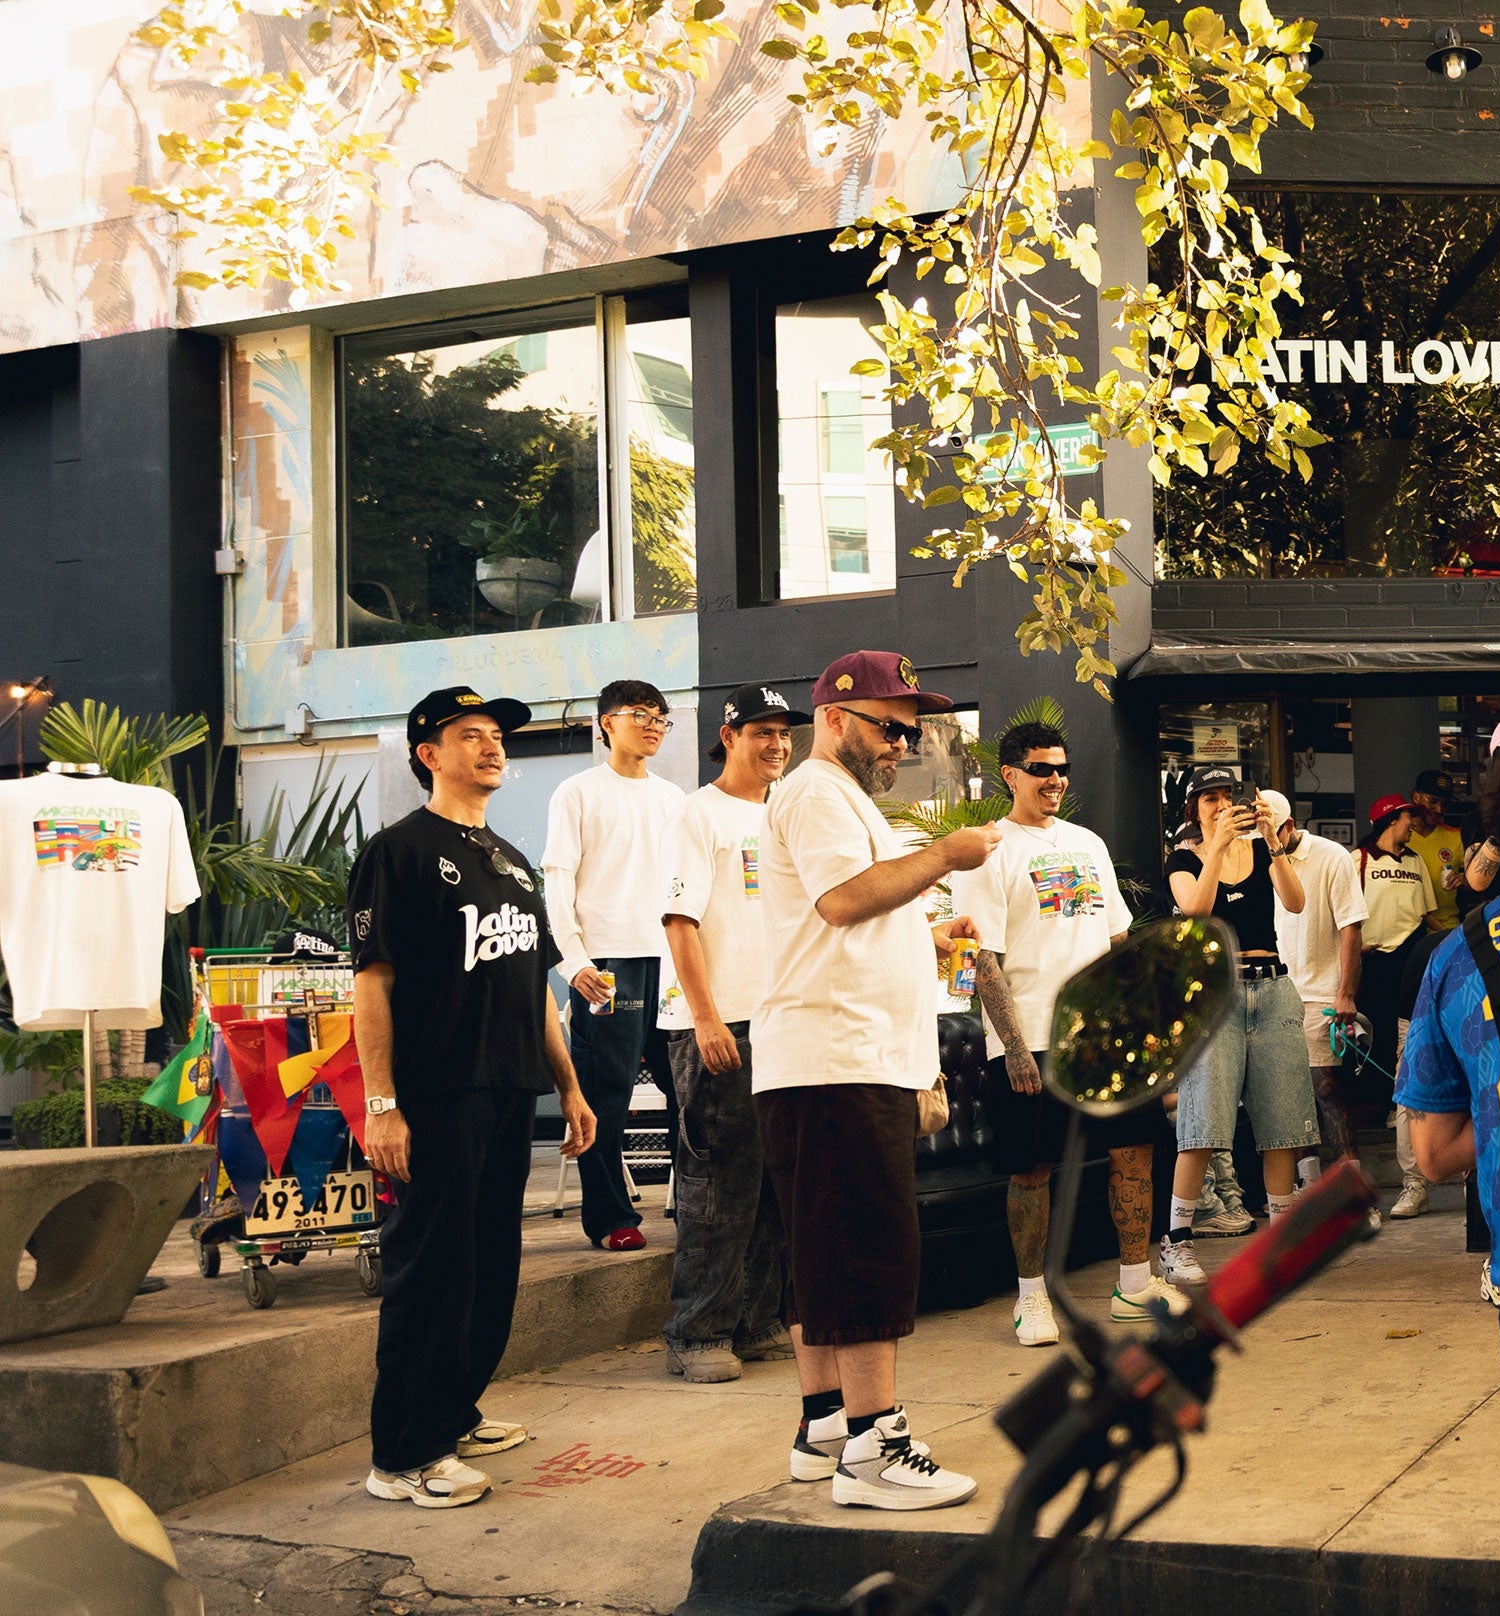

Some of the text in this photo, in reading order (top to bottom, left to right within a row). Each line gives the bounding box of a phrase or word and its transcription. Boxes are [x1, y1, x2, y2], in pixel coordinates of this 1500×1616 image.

[1031, 437, 1081, 467] OVER
[281, 1175, 337, 1189] PAA
[253, 1183, 367, 1221] 493470
[294, 1217, 326, 1229] 2011
